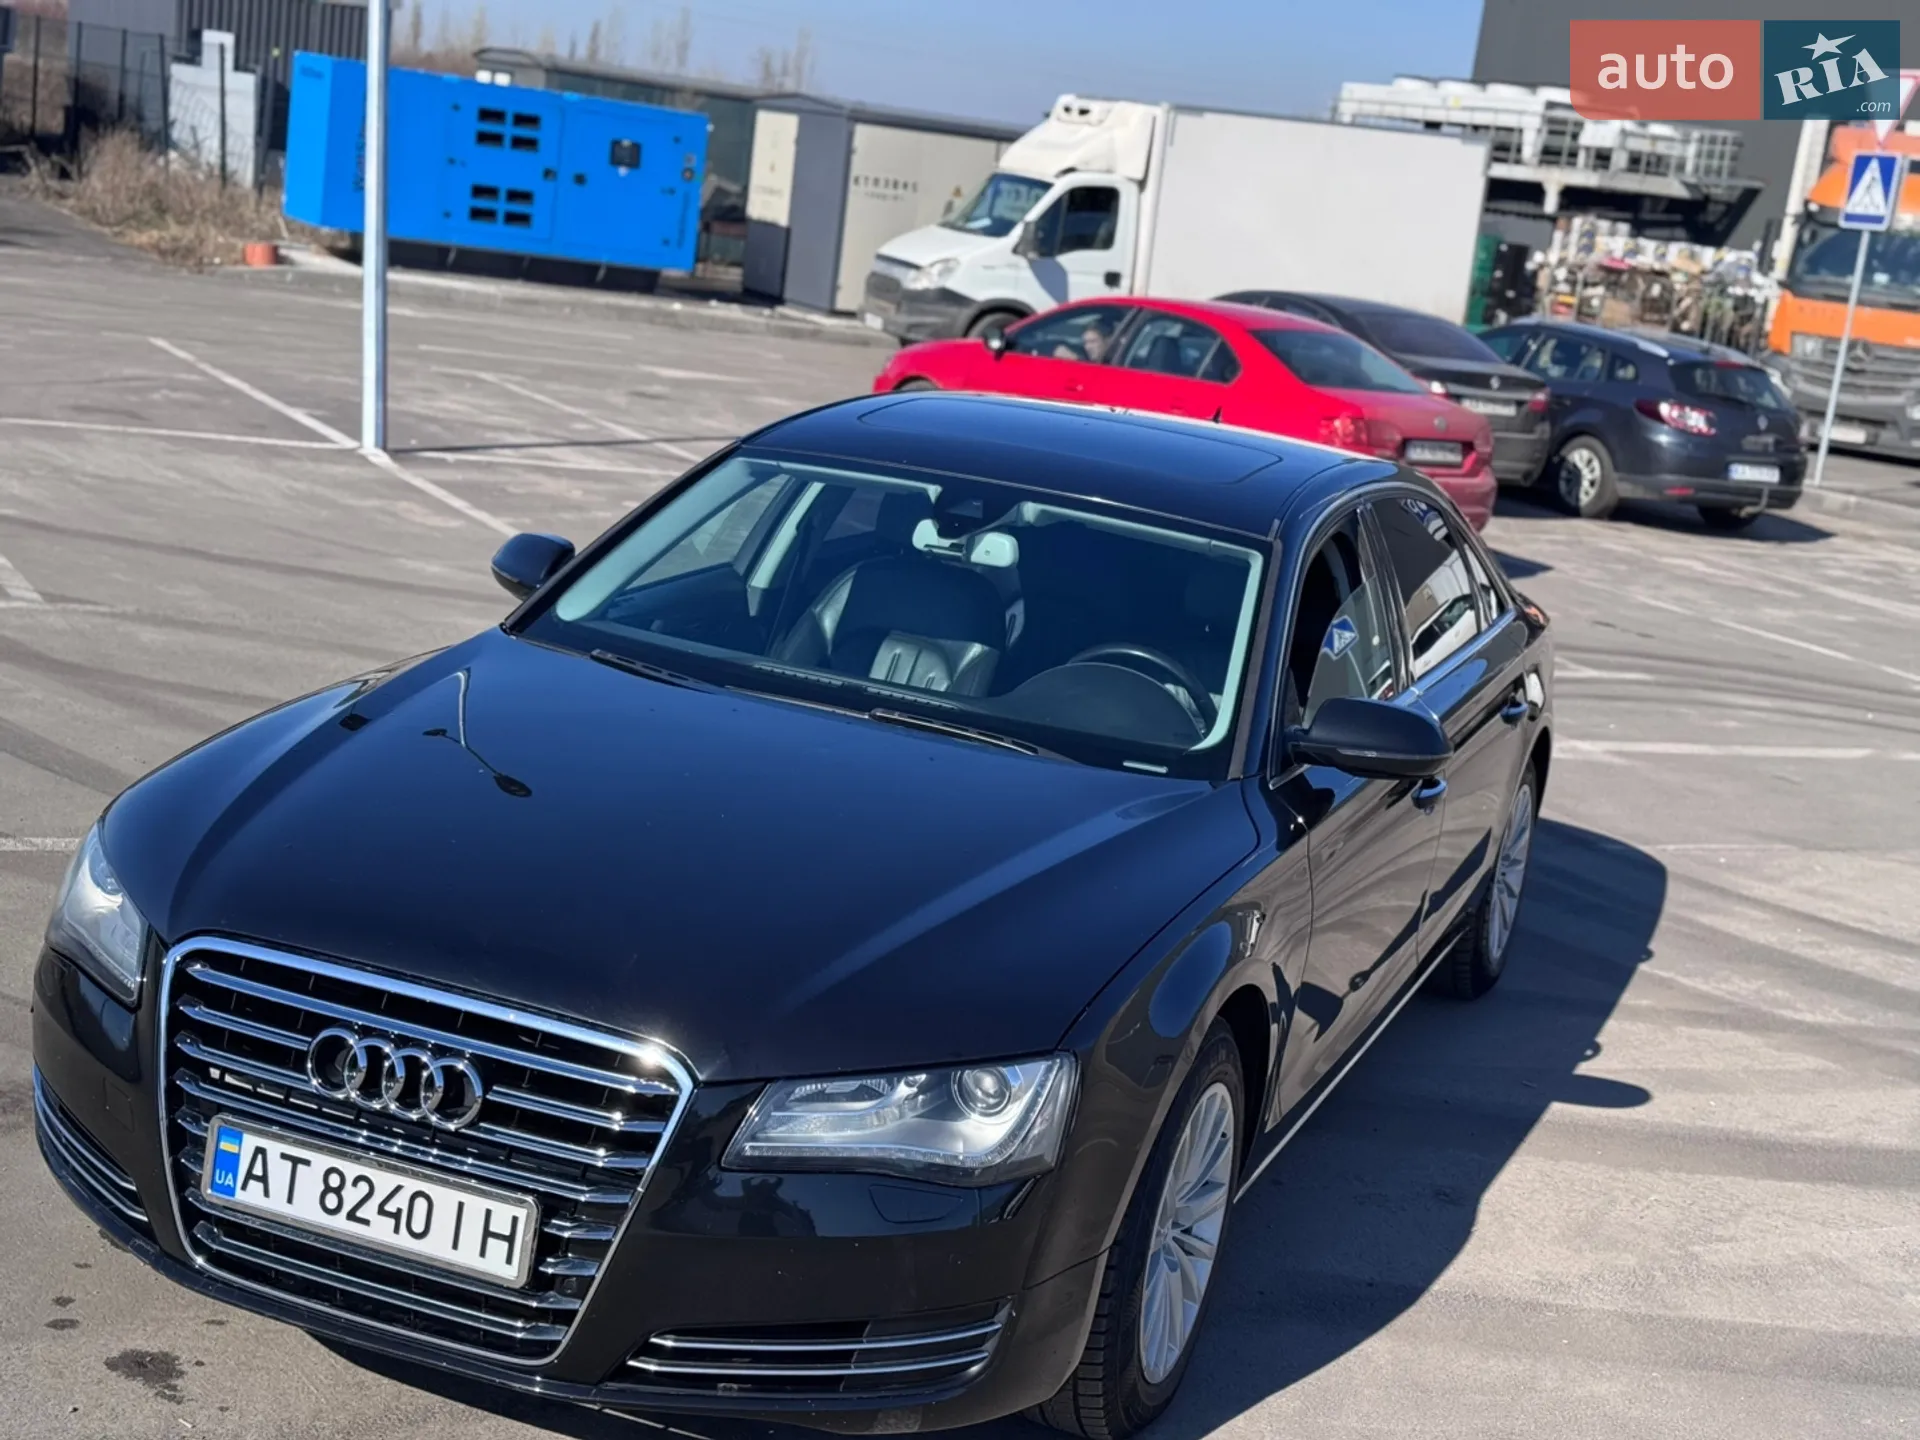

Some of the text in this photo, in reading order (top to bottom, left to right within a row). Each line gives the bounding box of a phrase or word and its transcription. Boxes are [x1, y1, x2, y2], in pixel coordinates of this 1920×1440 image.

[214, 1167, 235, 1189] UA
[240, 1146, 520, 1266] AT 8240 IH
